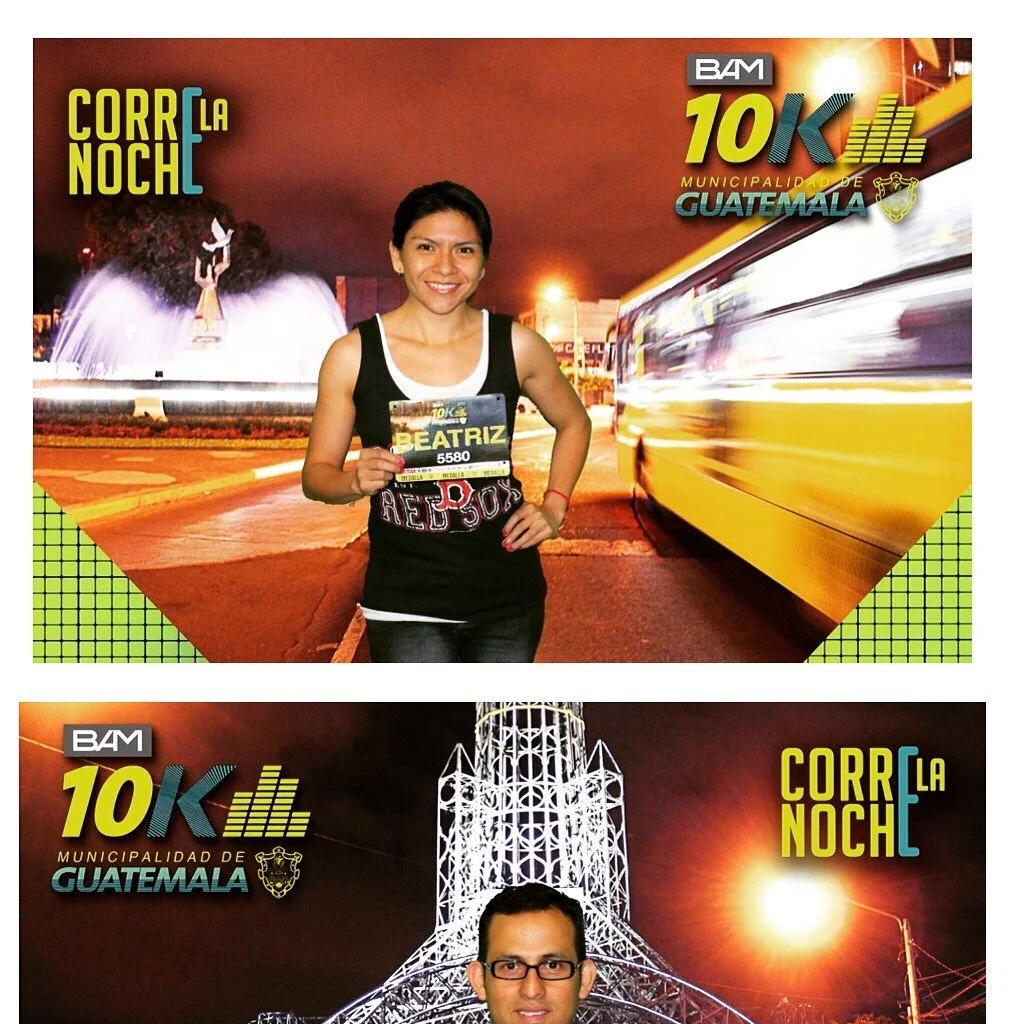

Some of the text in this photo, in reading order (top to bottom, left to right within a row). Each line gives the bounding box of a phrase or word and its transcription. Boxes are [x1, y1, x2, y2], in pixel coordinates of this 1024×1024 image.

[394, 425, 507, 455] BEATRIZ
[437, 451, 470, 464] 5580
[380, 489, 448, 531] RED
[459, 478, 523, 528] SOX
